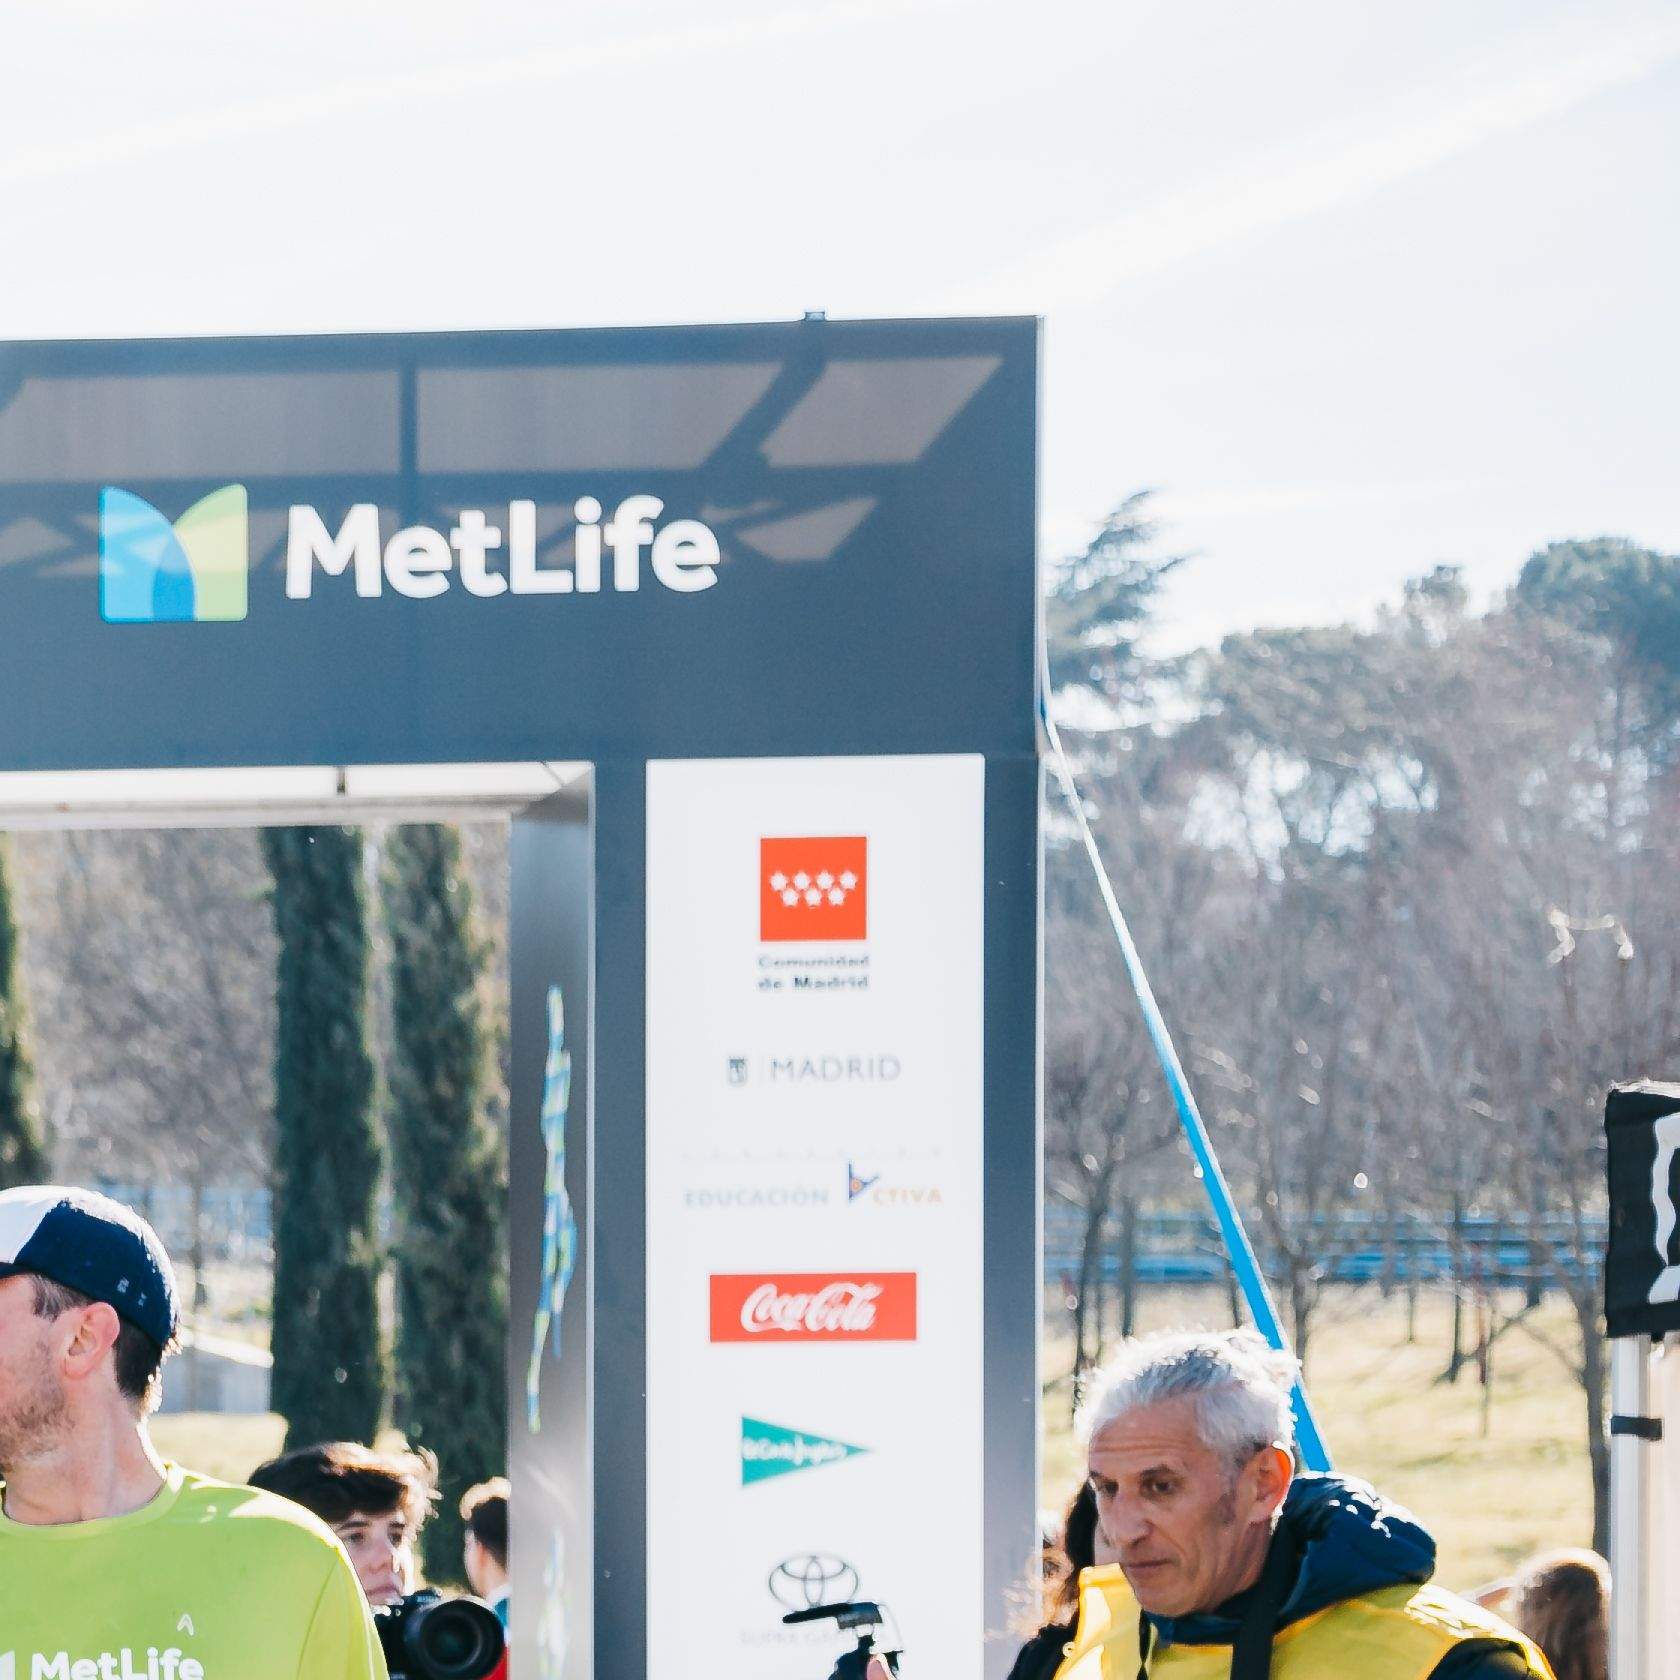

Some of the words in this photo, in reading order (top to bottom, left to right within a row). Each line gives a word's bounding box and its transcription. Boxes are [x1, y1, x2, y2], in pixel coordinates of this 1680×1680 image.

[285, 494, 722, 600] MetLife
[758, 954, 870, 970] Comunidad
[758, 975, 783, 990] de
[793, 974, 870, 990] Madrid
[770, 1055, 903, 1083] MADRID
